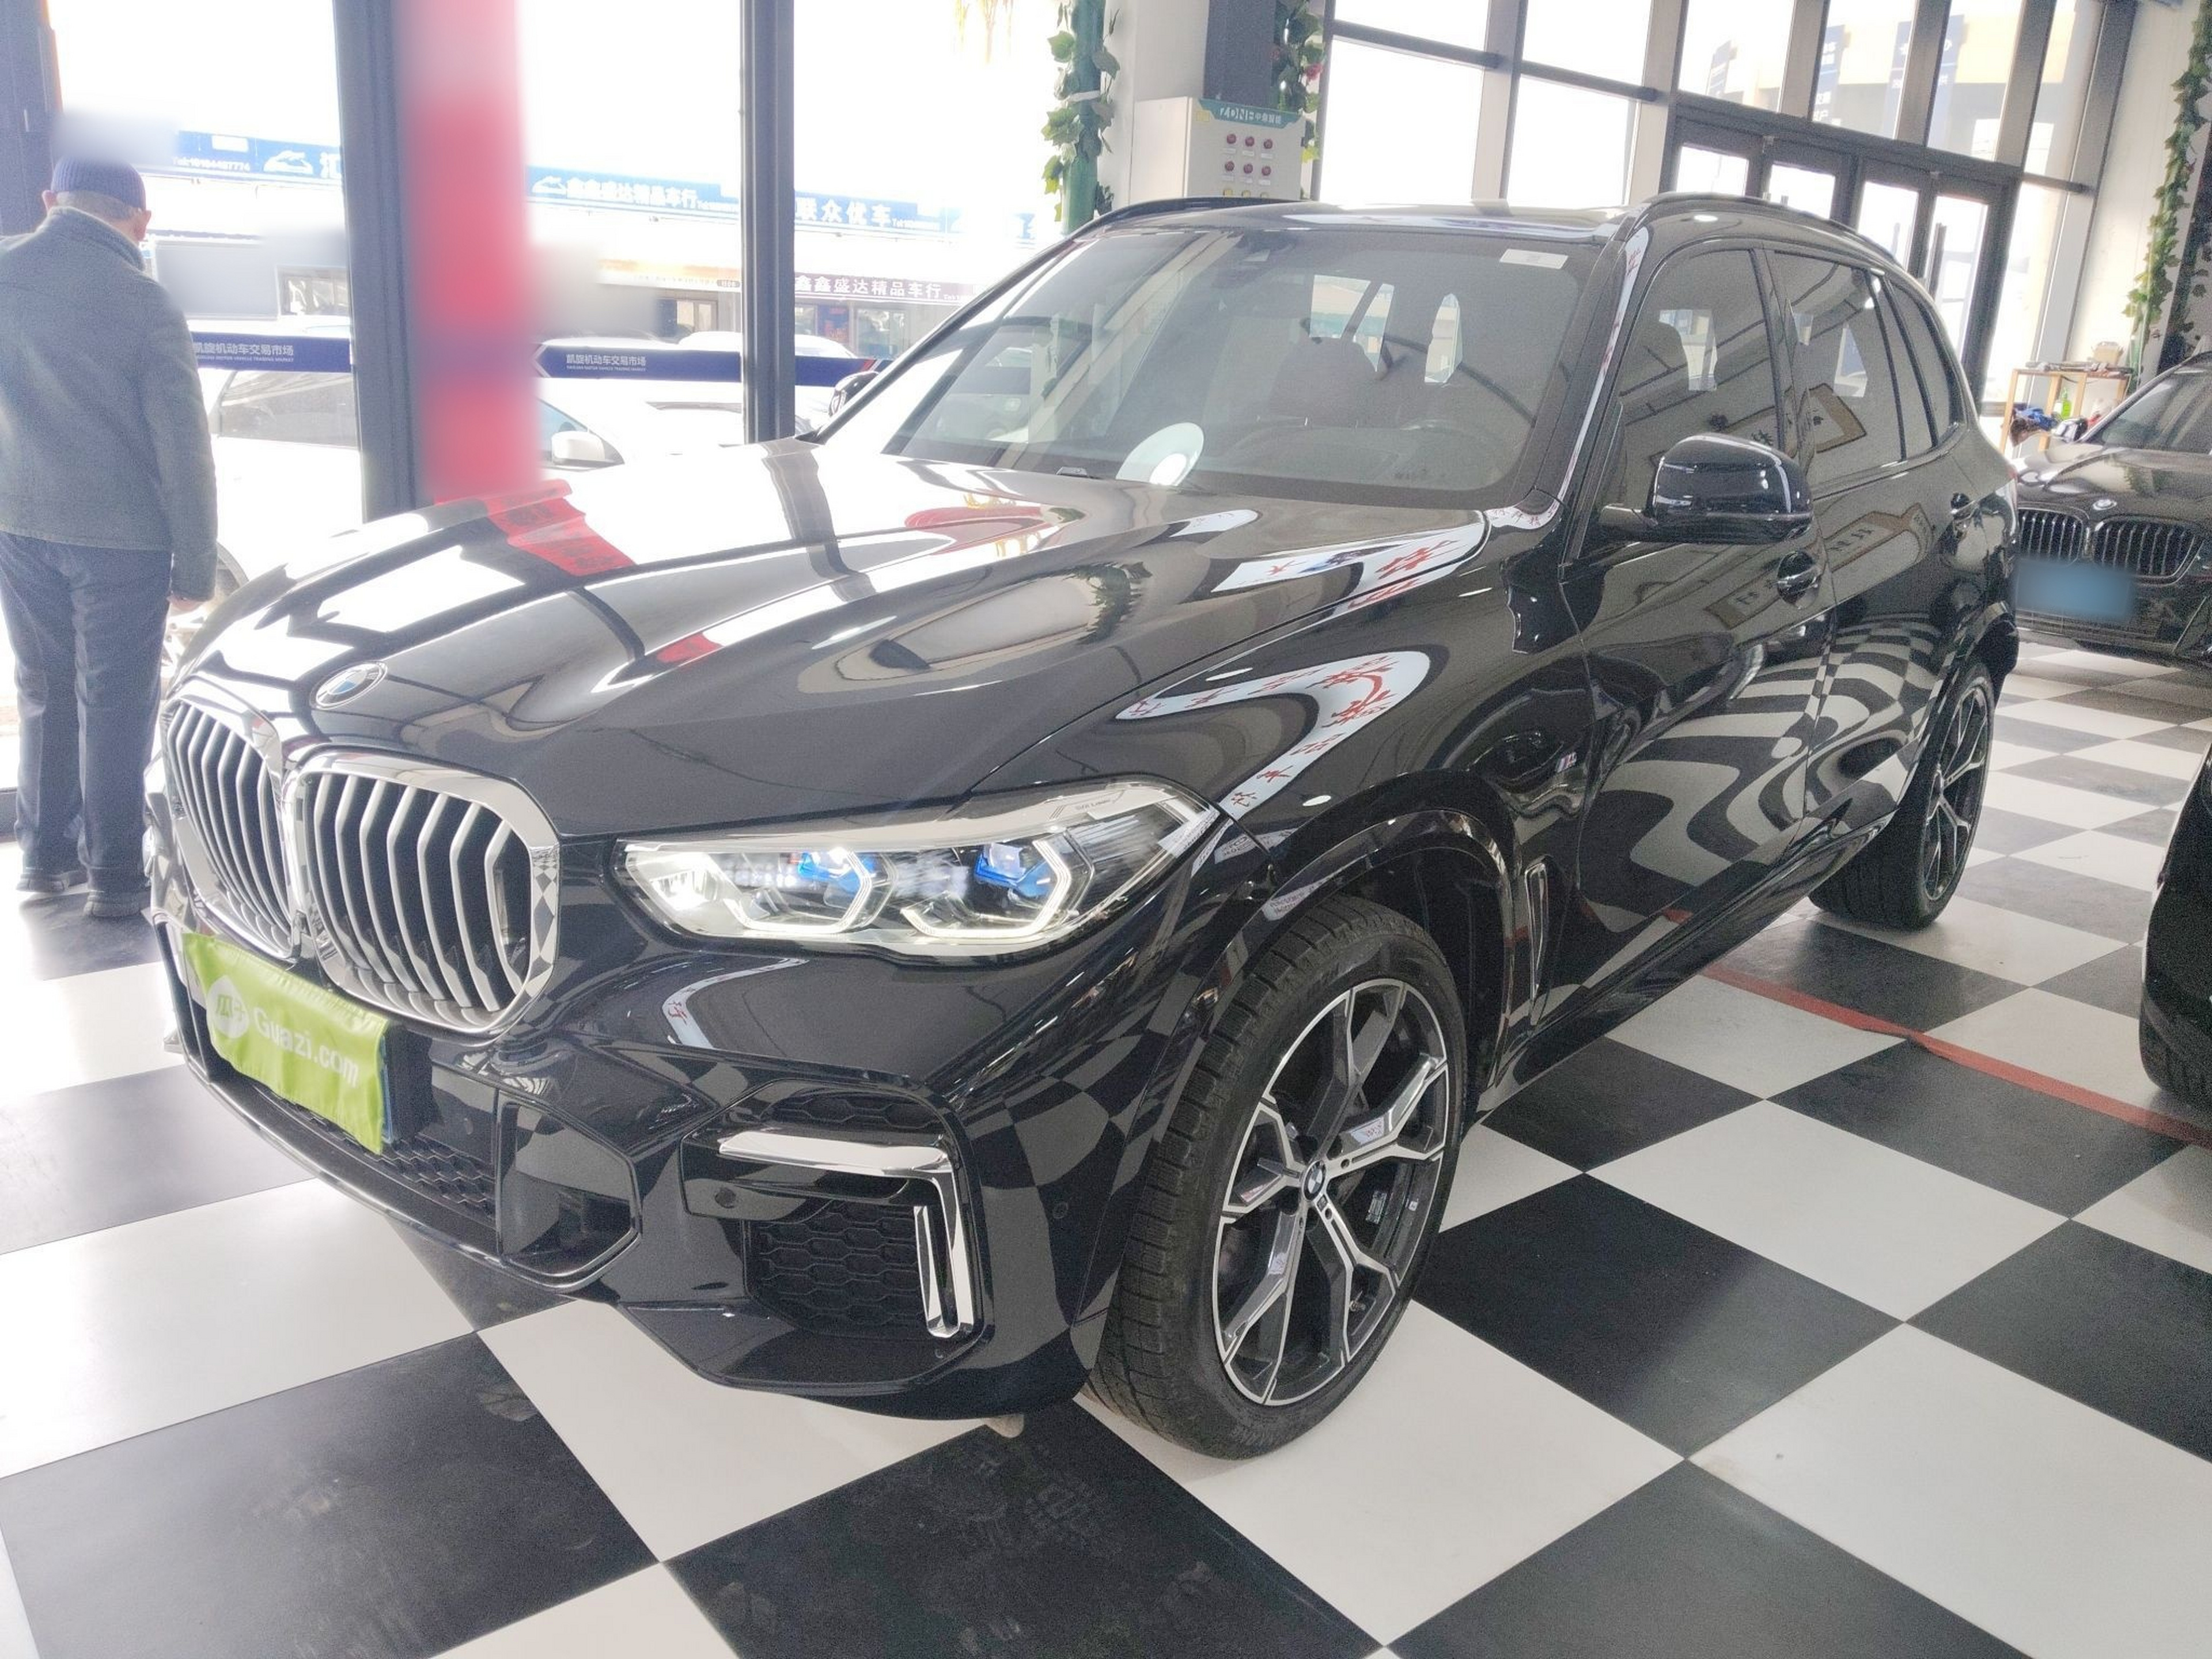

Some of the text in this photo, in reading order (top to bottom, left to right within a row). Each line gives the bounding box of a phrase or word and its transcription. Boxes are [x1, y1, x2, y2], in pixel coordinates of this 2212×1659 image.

[795, 274, 941, 299] 鑫鑫盛达精品车行
[253, 1006, 359, 1088] Guazi.com
